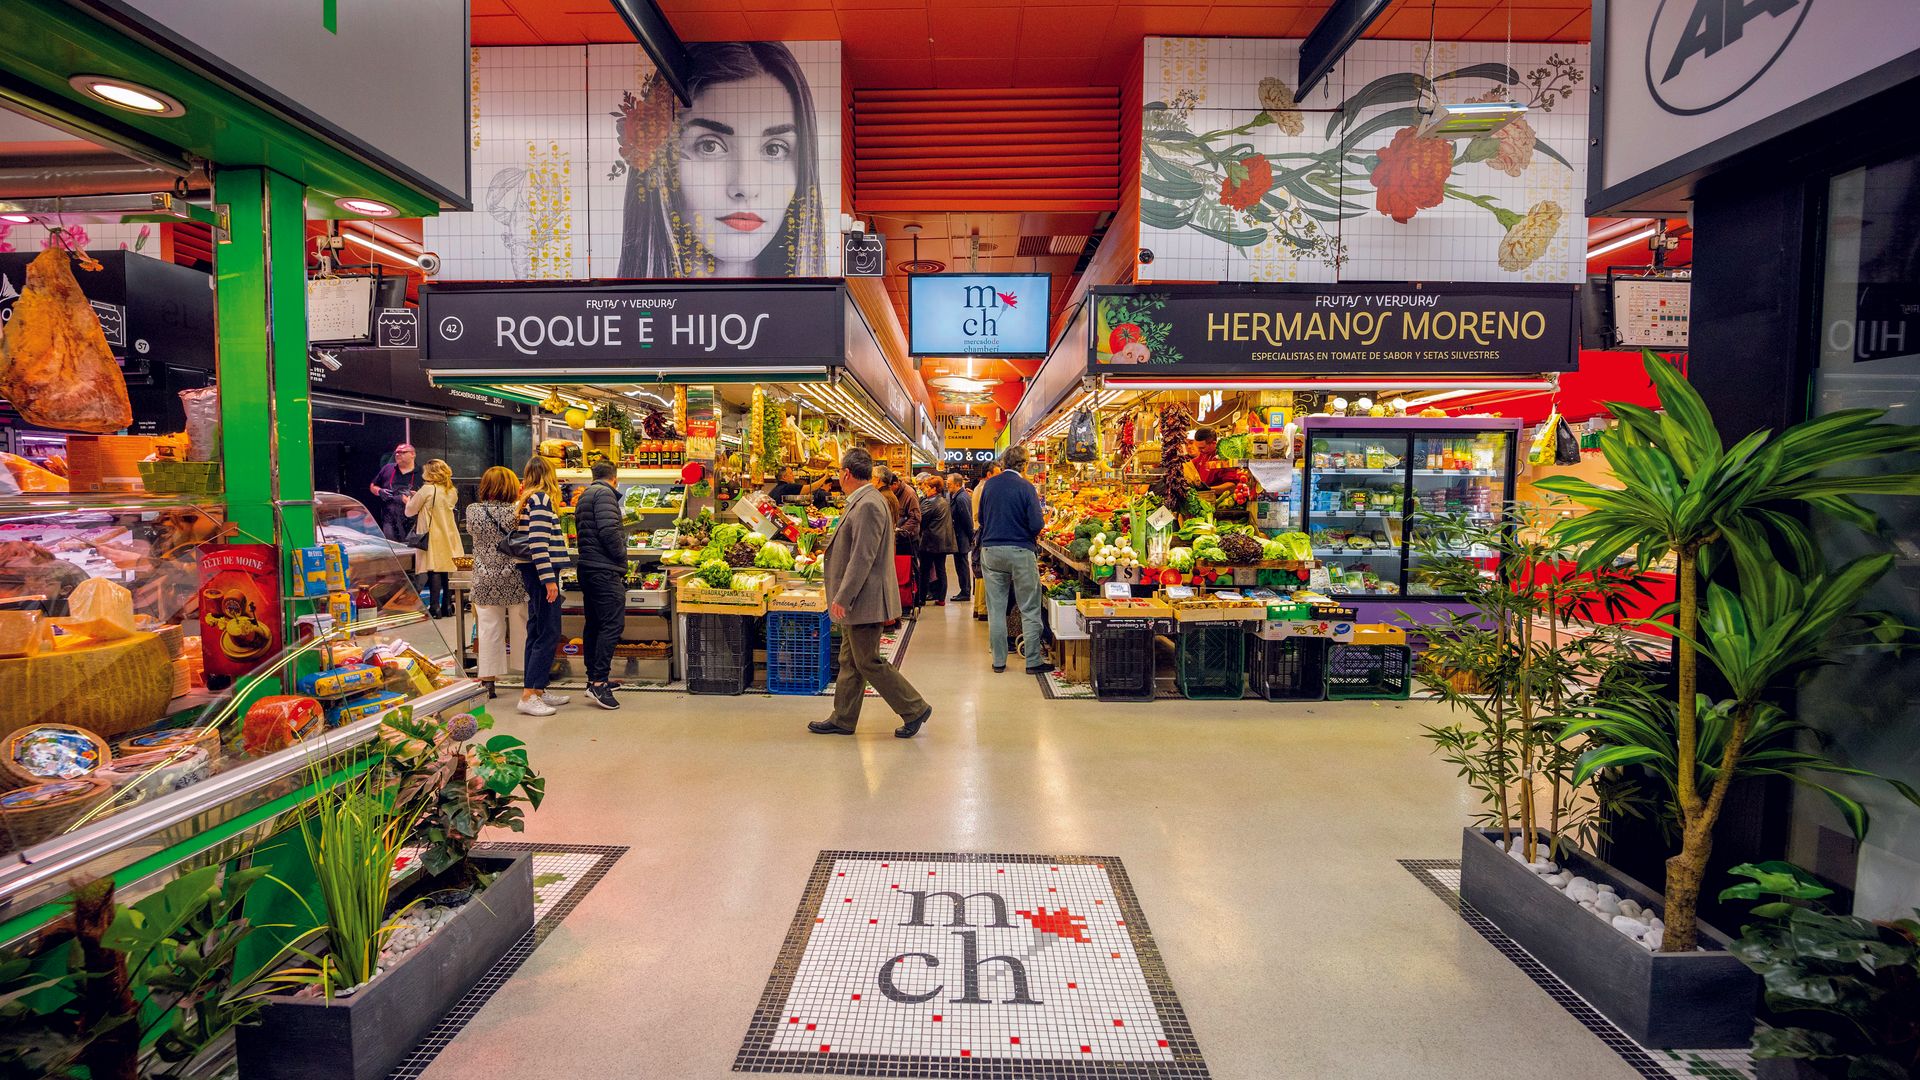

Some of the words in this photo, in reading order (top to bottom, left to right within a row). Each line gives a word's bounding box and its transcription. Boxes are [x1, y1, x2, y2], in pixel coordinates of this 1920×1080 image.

[963, 285, 999, 308] m
[1315, 295, 1361, 307] FRUTAS
[1365, 297, 1371, 306] Y
[1375, 294, 1440, 307] VERDURAS
[586, 299, 620, 310] FRUTAS
[621, 300, 628, 308] Y
[629, 298, 678, 309] VERDURAS
[446, 324, 457, 333] 42
[962, 308, 998, 336] ch
[1207, 311, 1392, 347] HERMANOS
[1402, 310, 1546, 346] MORENO
[496, 315, 622, 355] ROQUE
[672, 313, 770, 352] HIJOS
[138, 342, 147, 351] 57
[1251, 352, 1315, 361] ESPECIALISTAS
[1317, 352, 1328, 361] EN
[1331, 352, 1367, 361] TOMATE
[1369, 351, 1381, 360] DE
[1383, 351, 1413, 360] SABOR
[1415, 351, 1421, 360] Y
[1423, 351, 1449, 360] SETAS
[1450, 351, 1500, 360] SILVESTRES
[966, 452, 974, 461] &
[976, 452, 993, 461] GO
[223, 556, 234, 565] DE
[236, 556, 264, 570] MOINE
[896, 889, 1019, 928] m
[877, 931, 1044, 1004] ch
